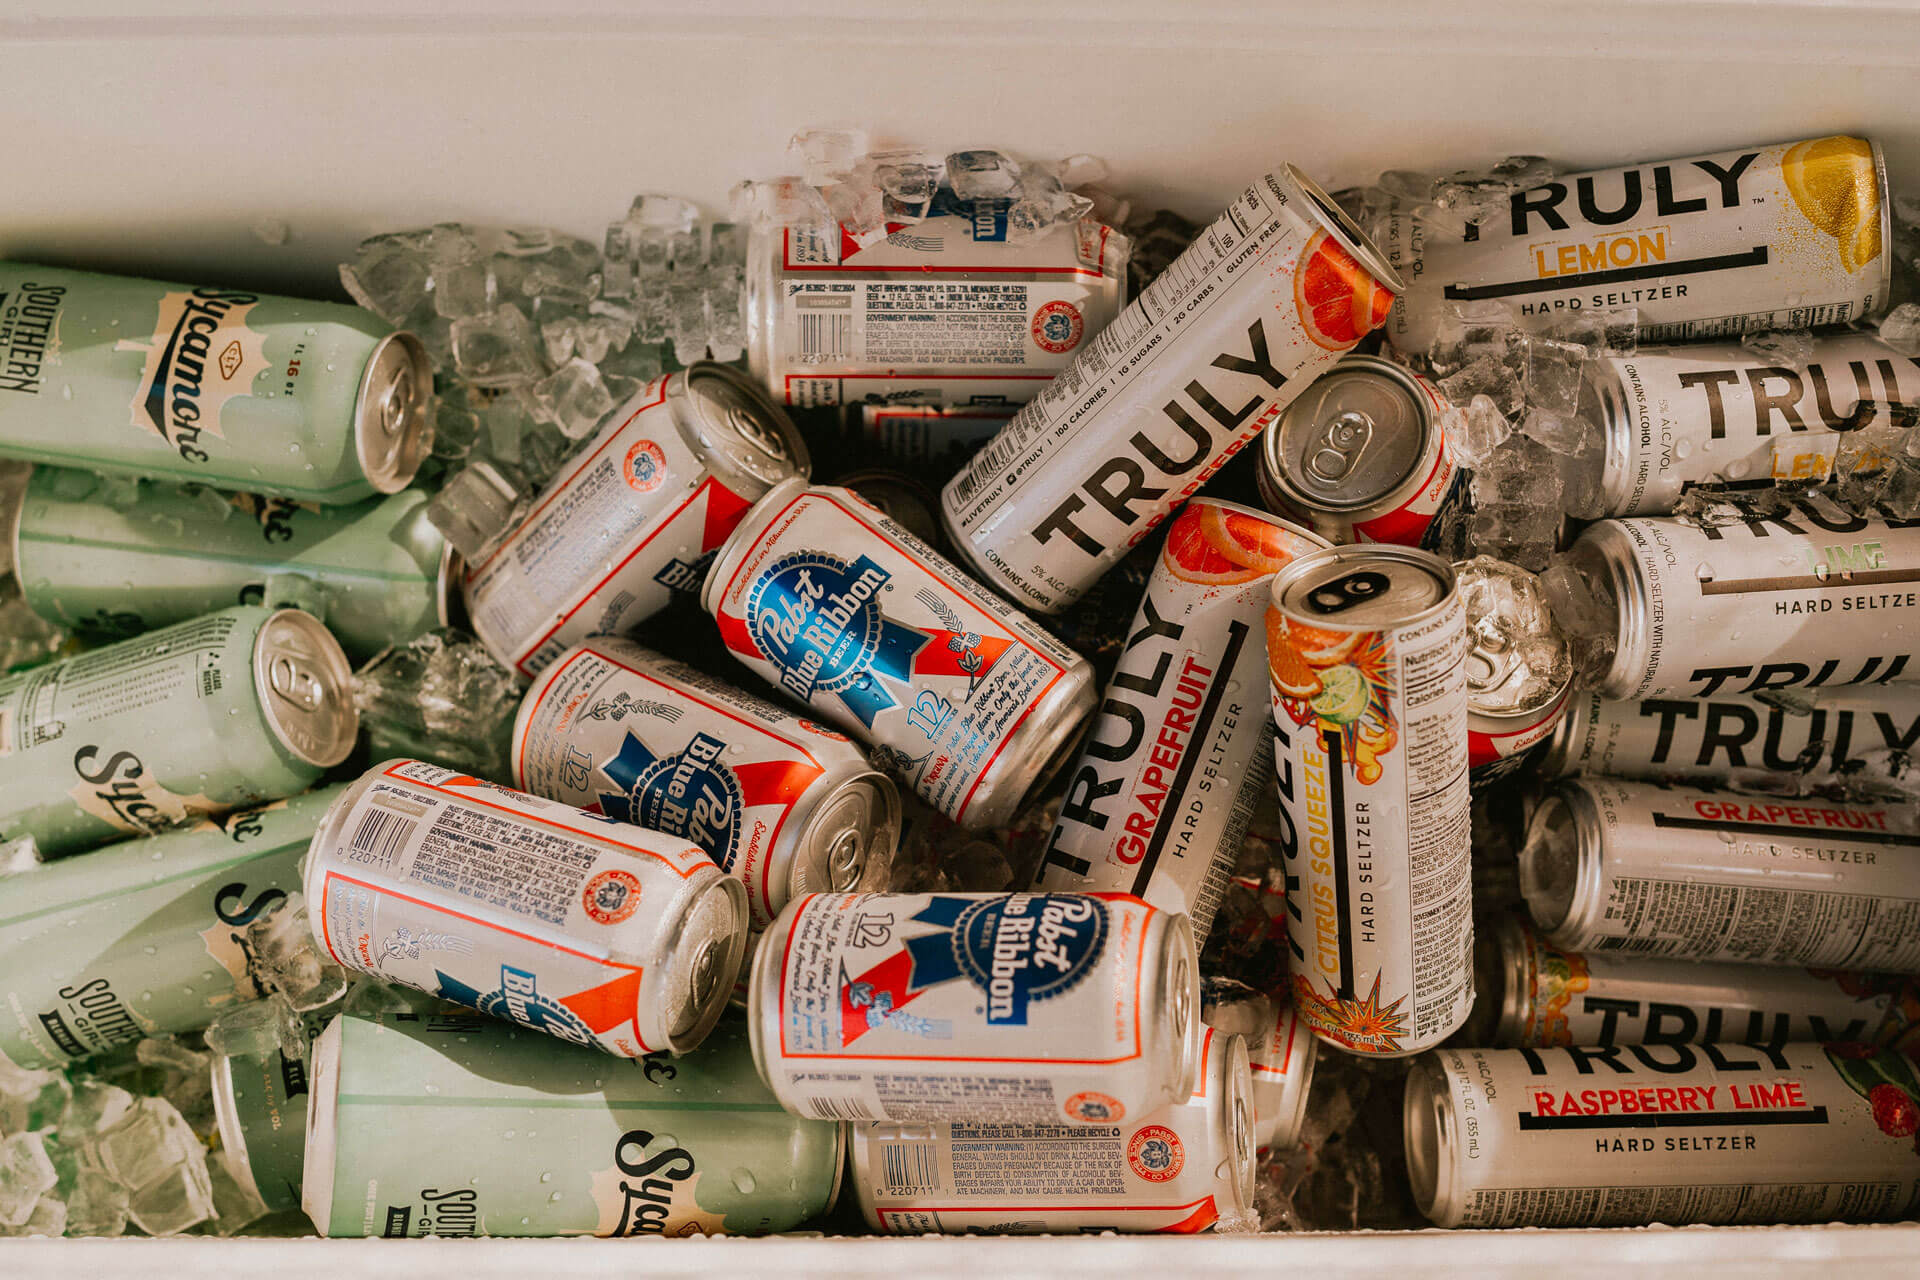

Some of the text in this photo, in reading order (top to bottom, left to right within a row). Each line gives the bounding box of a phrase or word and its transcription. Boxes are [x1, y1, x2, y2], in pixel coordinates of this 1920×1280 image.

[1464, 153, 1762, 242] RULY
[1535, 232, 1667, 279] LEMON
[1521, 283, 1689, 317] HARD SELTZER
[0, 282, 66, 394] SOUTHERN
[1053, 422, 1070, 438] 100
[1067, 385, 1108, 424] CALORIES
[1117, 364, 1130, 377] 1G
[1128, 333, 1163, 366] SUGARS
[1172, 310, 1187, 324] 2G
[1185, 283, 1215, 312] CARBS
[1225, 241, 1259, 274] GLUTEN
[1258, 219, 1282, 243] FREE
[163, 287, 258, 464] Sycamore
[223, 347, 239, 371] CLT
[286, 358, 300, 377] 16
[1624, 364, 1646, 404] CONTAINS
[1678, 355, 1920, 439] TRUL
[1031, 318, 1289, 557] TRULY
[1639, 404, 1651, 448] ALCOHOL
[1658, 418, 1672, 475] ALC/VOL
[1640, 460, 1651, 487] HARD
[983, 545, 1023, 587] CONTAINS
[1649, 528, 1681, 571] ALC/VOL
[1804, 542, 1890, 575] LIME
[1030, 563, 1047, 580] 5%
[1622, 518, 1664, 648] ALCOHOL HARD SELTZER WITH
[757, 569, 824, 655] Pabst
[1775, 593, 1920, 616] HARD SELTZE
[783, 567, 886, 701] Blue Ribbon
[829, 630, 857, 668] BEER
[1398, 619, 1443, 643] CONTAINS
[1405, 644, 1445, 666] Nutrition
[211, 668, 223, 691] PLEASE
[992, 689, 1011, 710] Only
[1407, 687, 1445, 706] Calories
[906, 689, 952, 739] 12
[1035, 595, 1185, 885] TRULY
[1116, 656, 1214, 865] GRAPEFRUIT
[563, 743, 593, 793] 12
[667, 737, 722, 800] Blue
[1173, 799, 1204, 858] HARD
[1199, 702, 1243, 793] SELTZER
[688, 782, 734, 851] Pab
[1693, 799, 1889, 831] GRAPEFRUIT
[1303, 749, 1339, 974] CITRUS SQUEEZE
[1355, 802, 1376, 942] HARD SELTZER
[1727, 841, 1878, 866] HARD SELTZER
[853, 911, 894, 949] 12
[1032, 894, 1091, 974] Pabst
[986, 913, 1035, 1023] Ribbon
[1476, 1060, 1496, 1104] ALC/VOL
[1536, 1083, 1806, 1117] RASPBERRY LIME
[951, 1143, 993, 1151] GOVERNMENT
[1035, 1143, 1069, 1151] ACCORDING
[1092, 1143, 1121, 1151] SURGEON
[981, 1129, 1110, 1137] PLEASE CALL PLEASE RECYCLE
[1465, 1116, 1478, 1137] (355
[1595, 1135, 1757, 1154] HARD SELTZER
[984, 1152, 1008, 1160] WOMEN
[1010, 1152, 1034, 1160] SHOULD
[1036, 1152, 1049, 1160] NOT
[1050, 1152, 1070, 1160] DRINK
[1071, 1152, 1108, 1160] ALCOHOLIC
[1097, 1161, 1111, 1169] RISK
[612, 1130, 696, 1237] Syca
[890, 1186, 933, 1196] 220711
[1042, 1187, 1063, 1195] CAUSE
